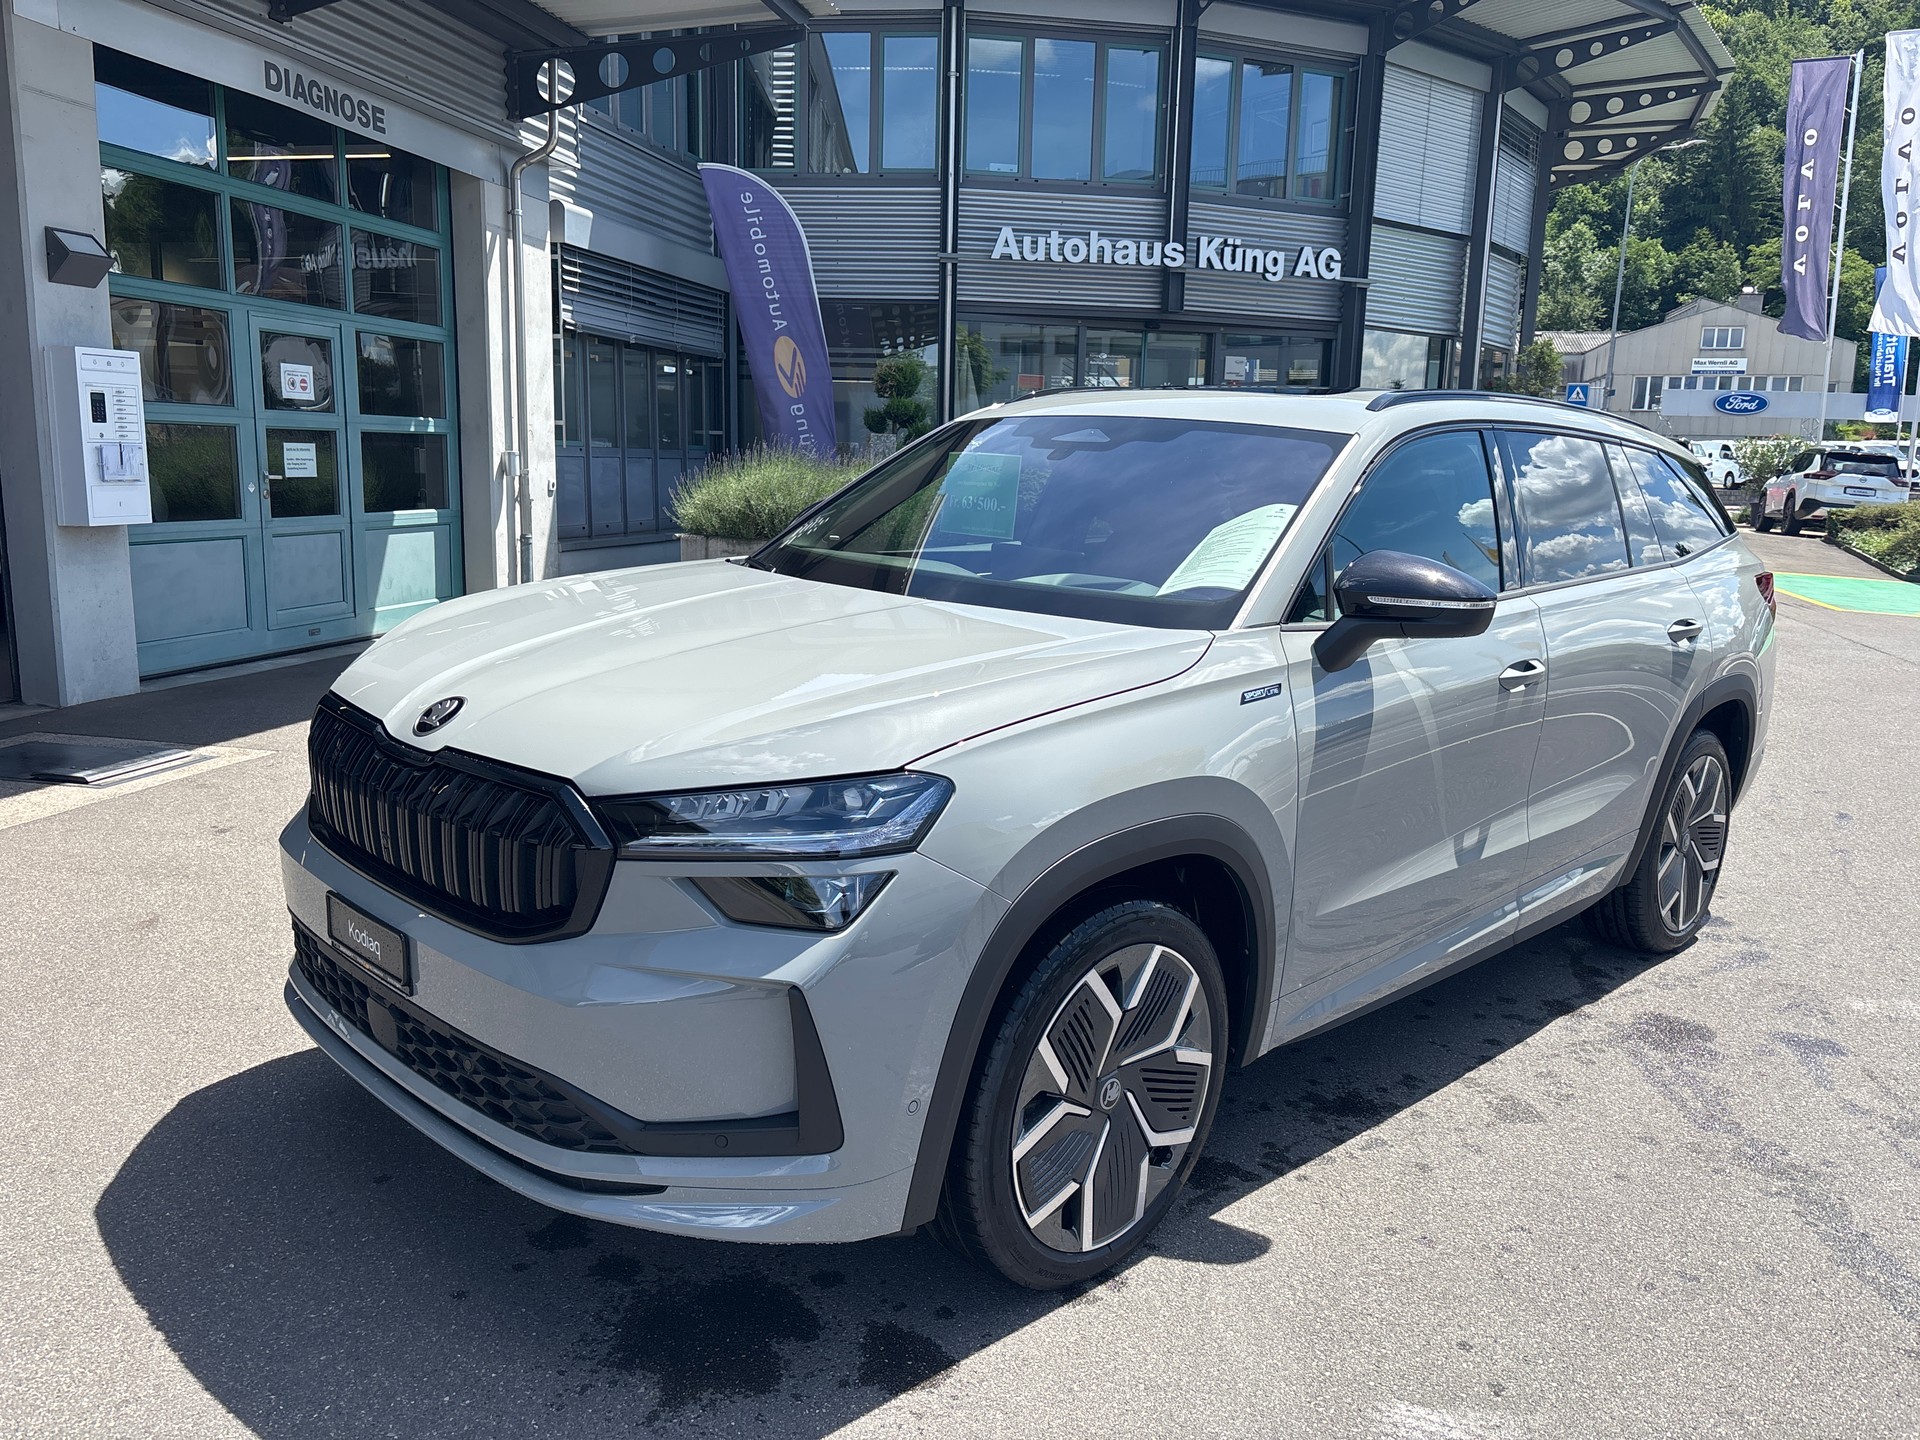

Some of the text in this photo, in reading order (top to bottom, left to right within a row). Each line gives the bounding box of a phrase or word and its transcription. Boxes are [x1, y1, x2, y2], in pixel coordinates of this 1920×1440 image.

[264, 60, 386, 135] DIAGNOSE
[990, 226, 1342, 282] Autohaus Küng AG
[1725, 395, 1759, 410] Ford
[347, 919, 381, 961] Kodiaq
